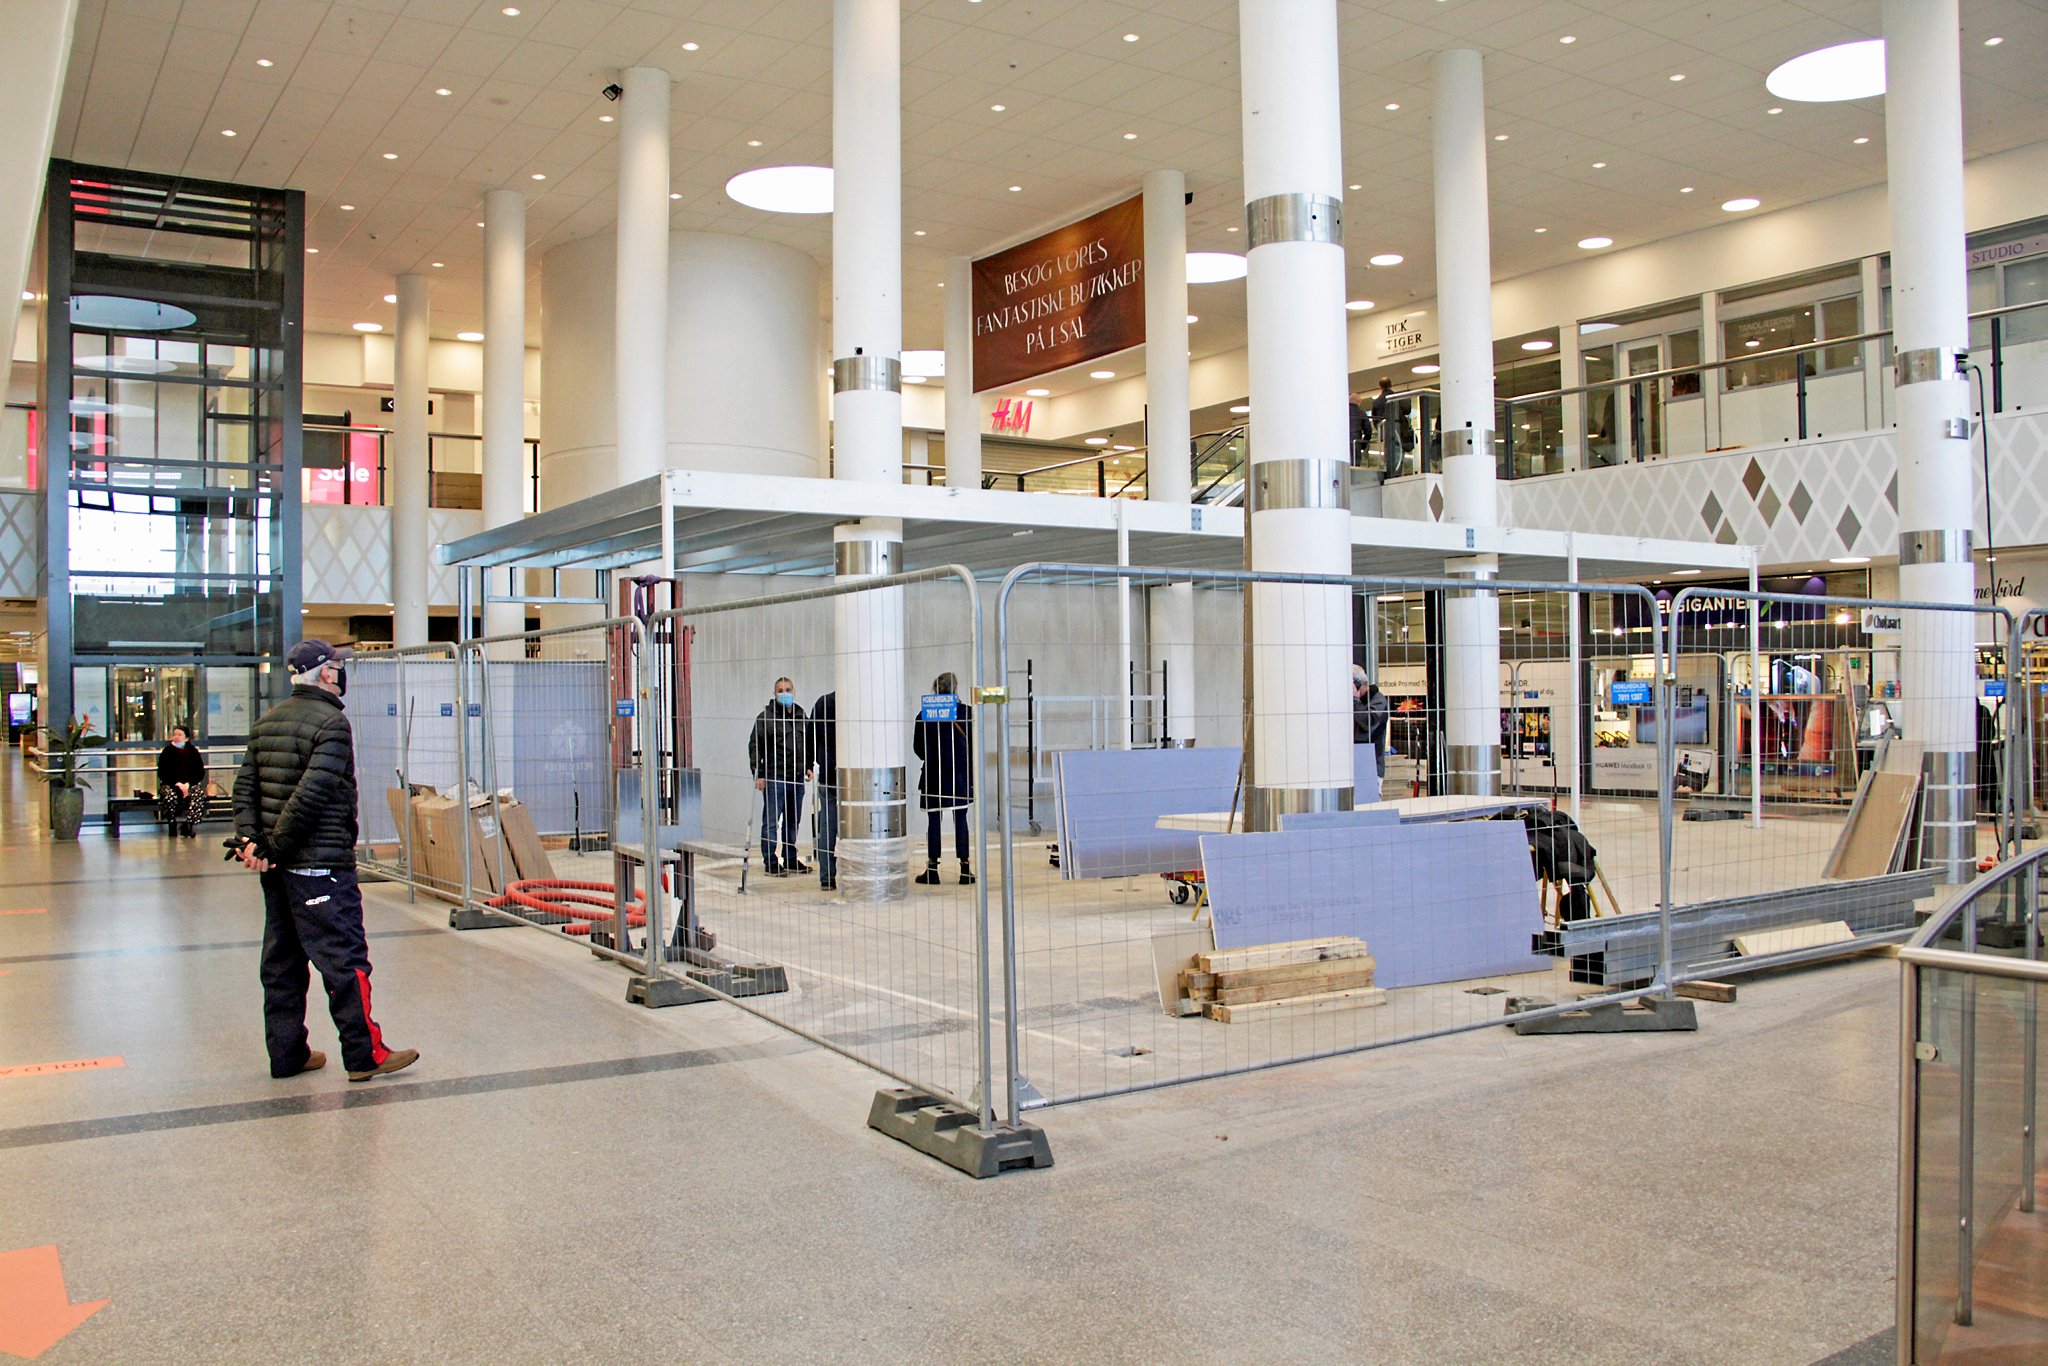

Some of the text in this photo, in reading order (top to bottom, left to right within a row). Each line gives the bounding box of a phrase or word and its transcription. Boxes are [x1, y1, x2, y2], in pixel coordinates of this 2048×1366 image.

[1004, 237, 1108, 296] BESØG VORES
[1972, 242, 2024, 263] STUDIO
[977, 258, 1142, 336] FANTASTISKE BUTIKKER
[1026, 316, 1087, 354] PÅ 1 SAL
[1385, 319, 1407, 335] TICK
[1385, 333, 1422, 350] TIGER
[991, 398, 1033, 433] H&M
